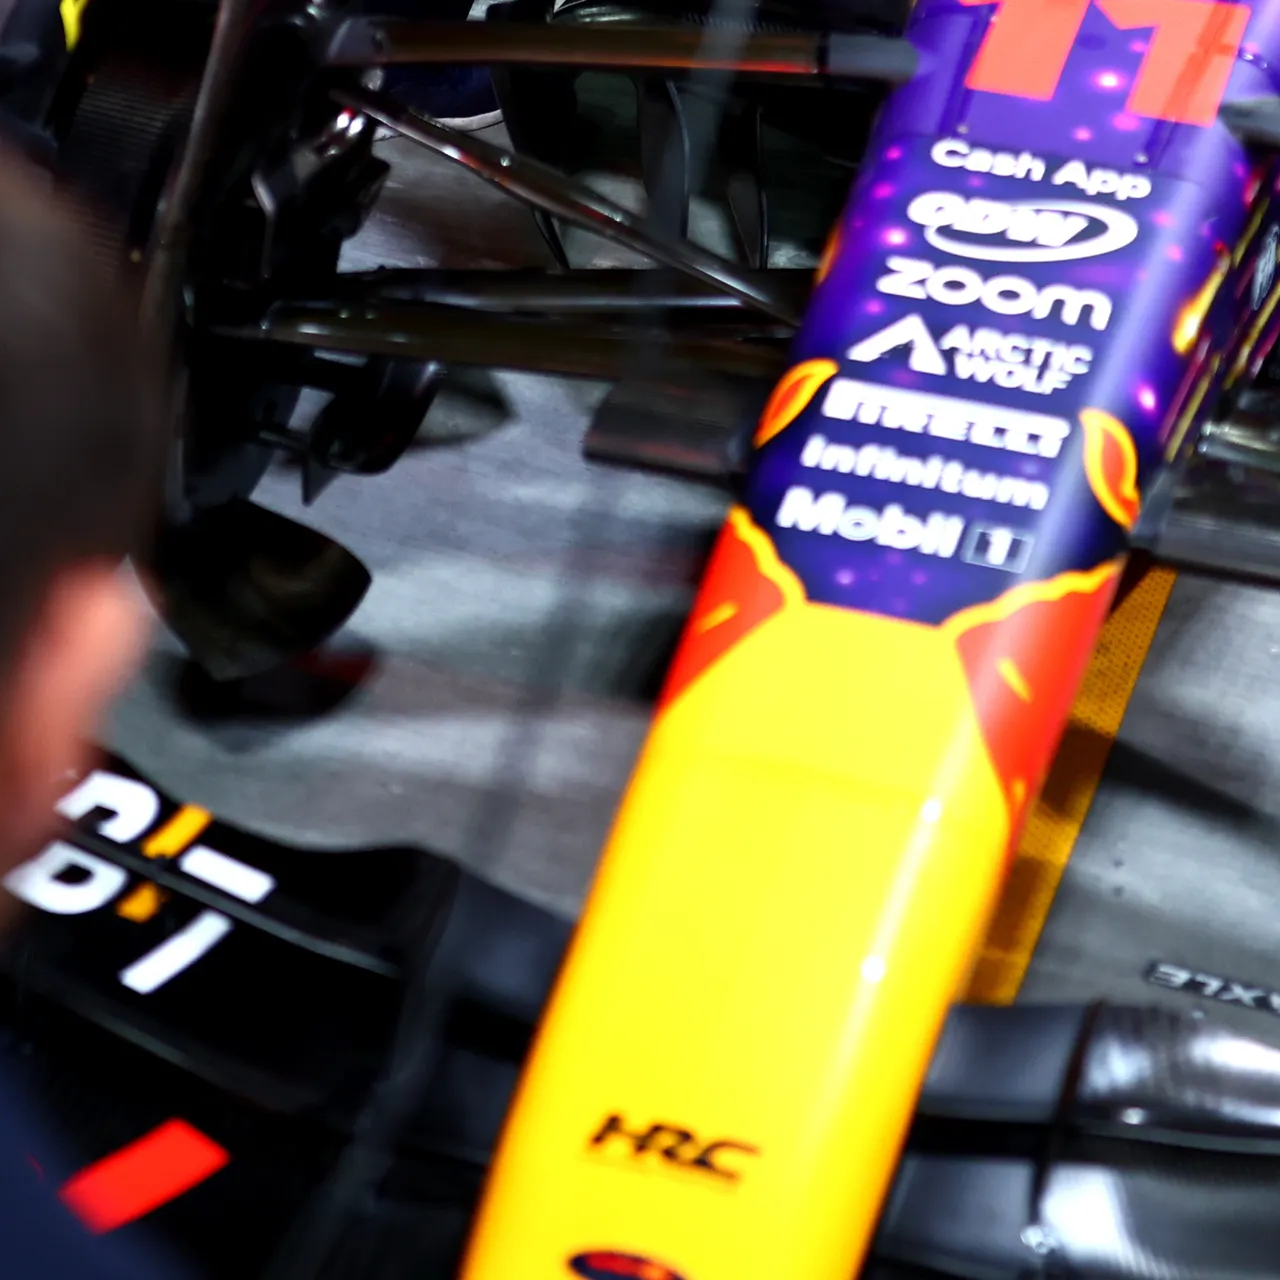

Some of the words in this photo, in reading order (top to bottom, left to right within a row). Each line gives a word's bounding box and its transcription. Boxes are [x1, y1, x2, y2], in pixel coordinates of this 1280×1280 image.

[930, 138, 1046, 182] Cash
[1051, 159, 1152, 200] App
[940, 323, 1094, 375] ARCTIC
[953, 352, 1074, 396] WOLF
[800, 434, 1049, 511] Infinitum
[775, 485, 966, 559] Mobil
[4, 769, 276, 995] BIT
[586, 1111, 762, 1183] HRC
